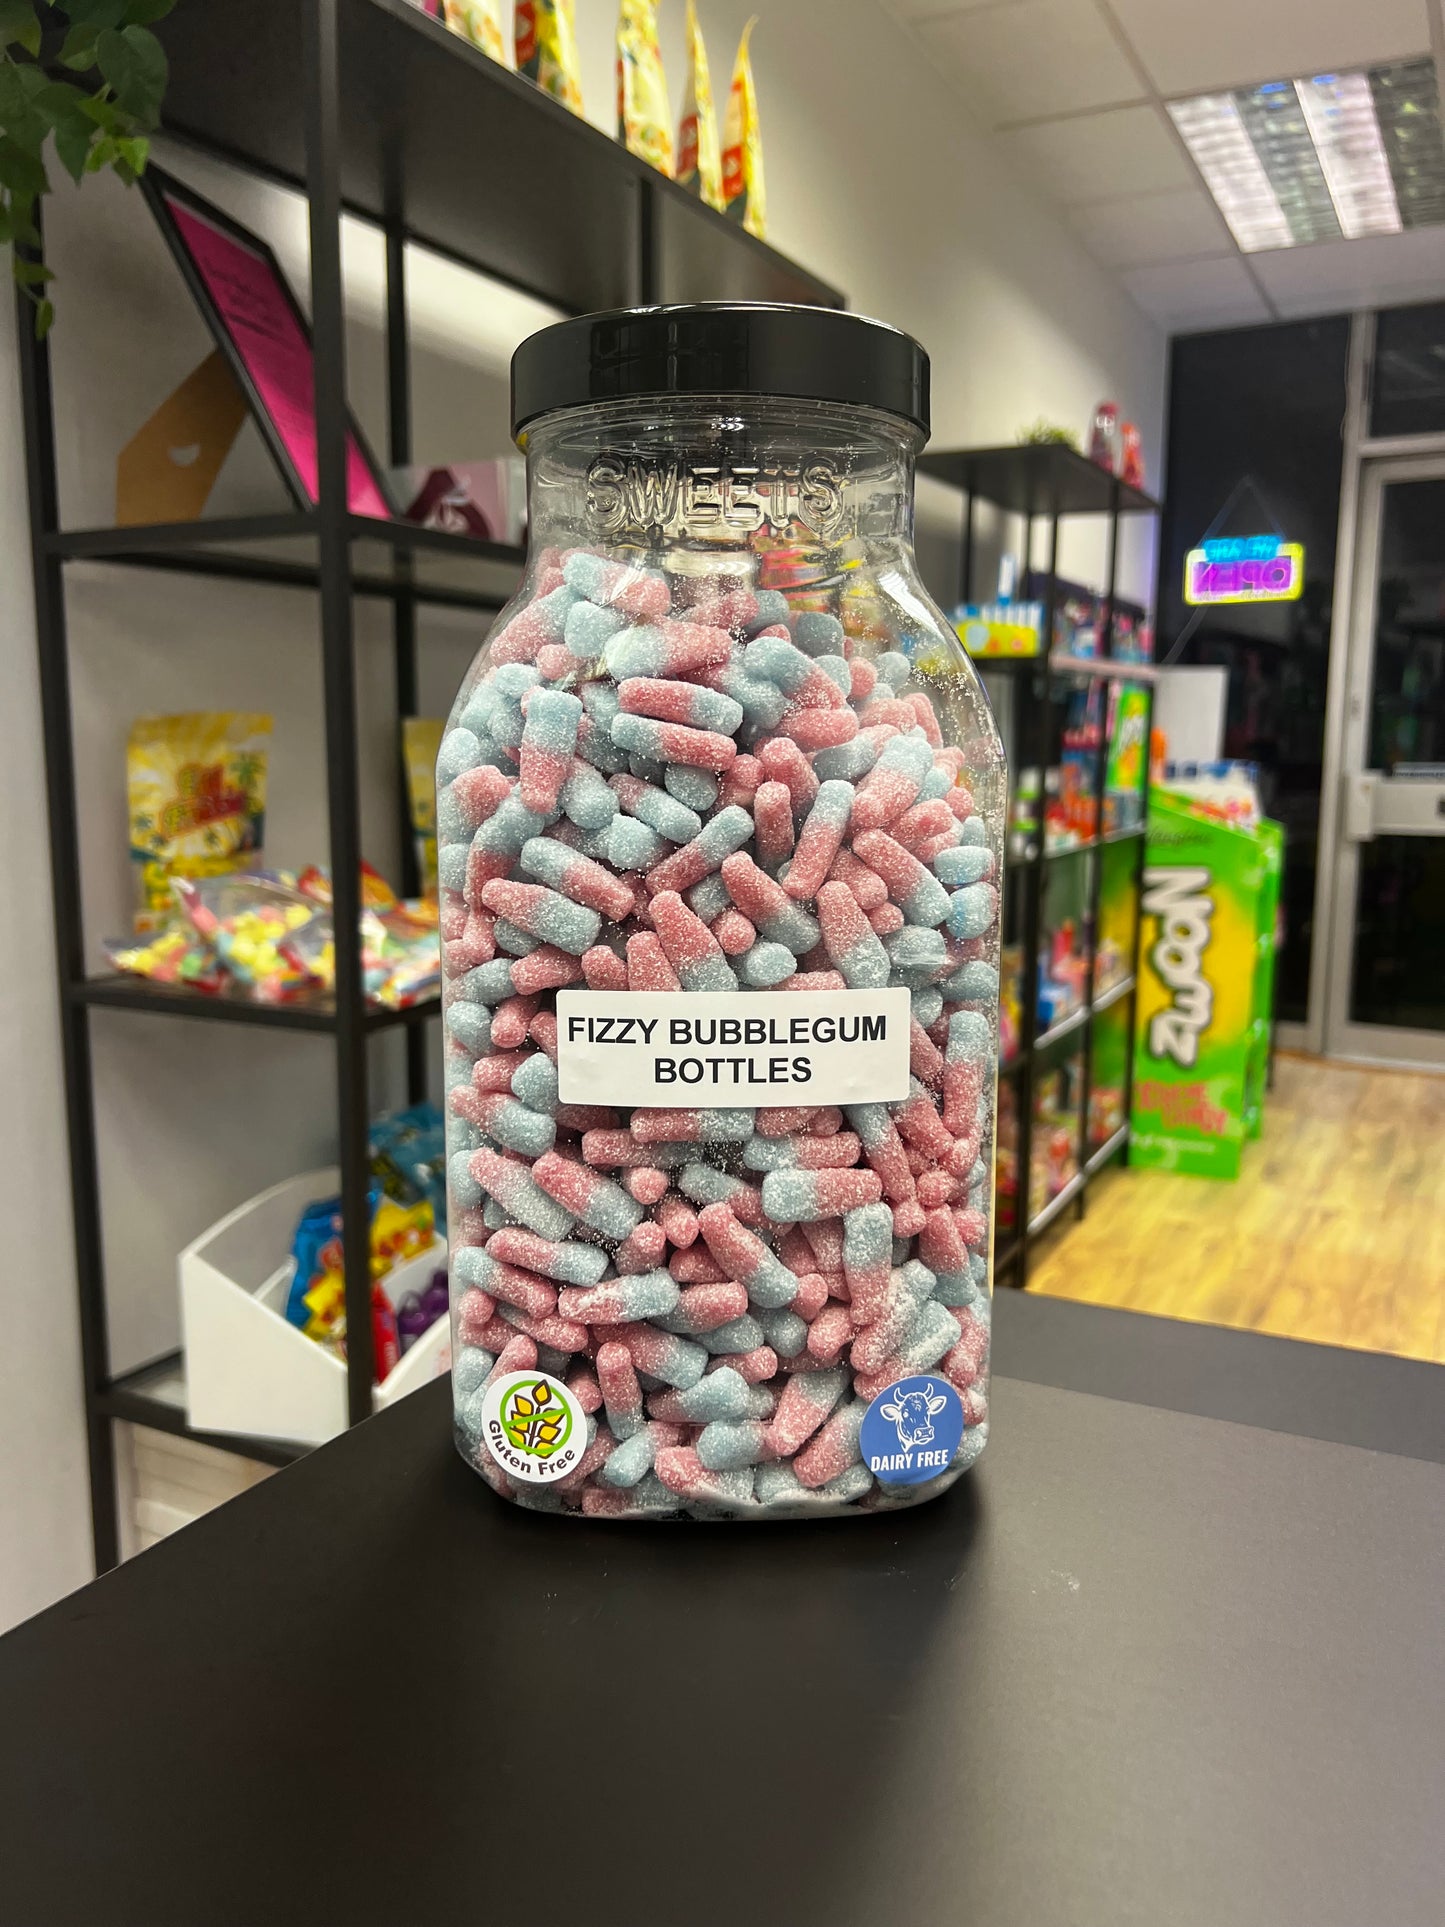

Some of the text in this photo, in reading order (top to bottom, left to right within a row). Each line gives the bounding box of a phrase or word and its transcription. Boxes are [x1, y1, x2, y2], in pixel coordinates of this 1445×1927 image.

[586, 456, 843, 533] SWEETS
[567, 1015, 887, 1045] FIZZY BUBBLEGUM
[654, 1056, 812, 1084] BOTTLES
[488, 1419, 576, 1475] Gluten Free
[870, 1449, 949, 1472] DAIRY FREE
